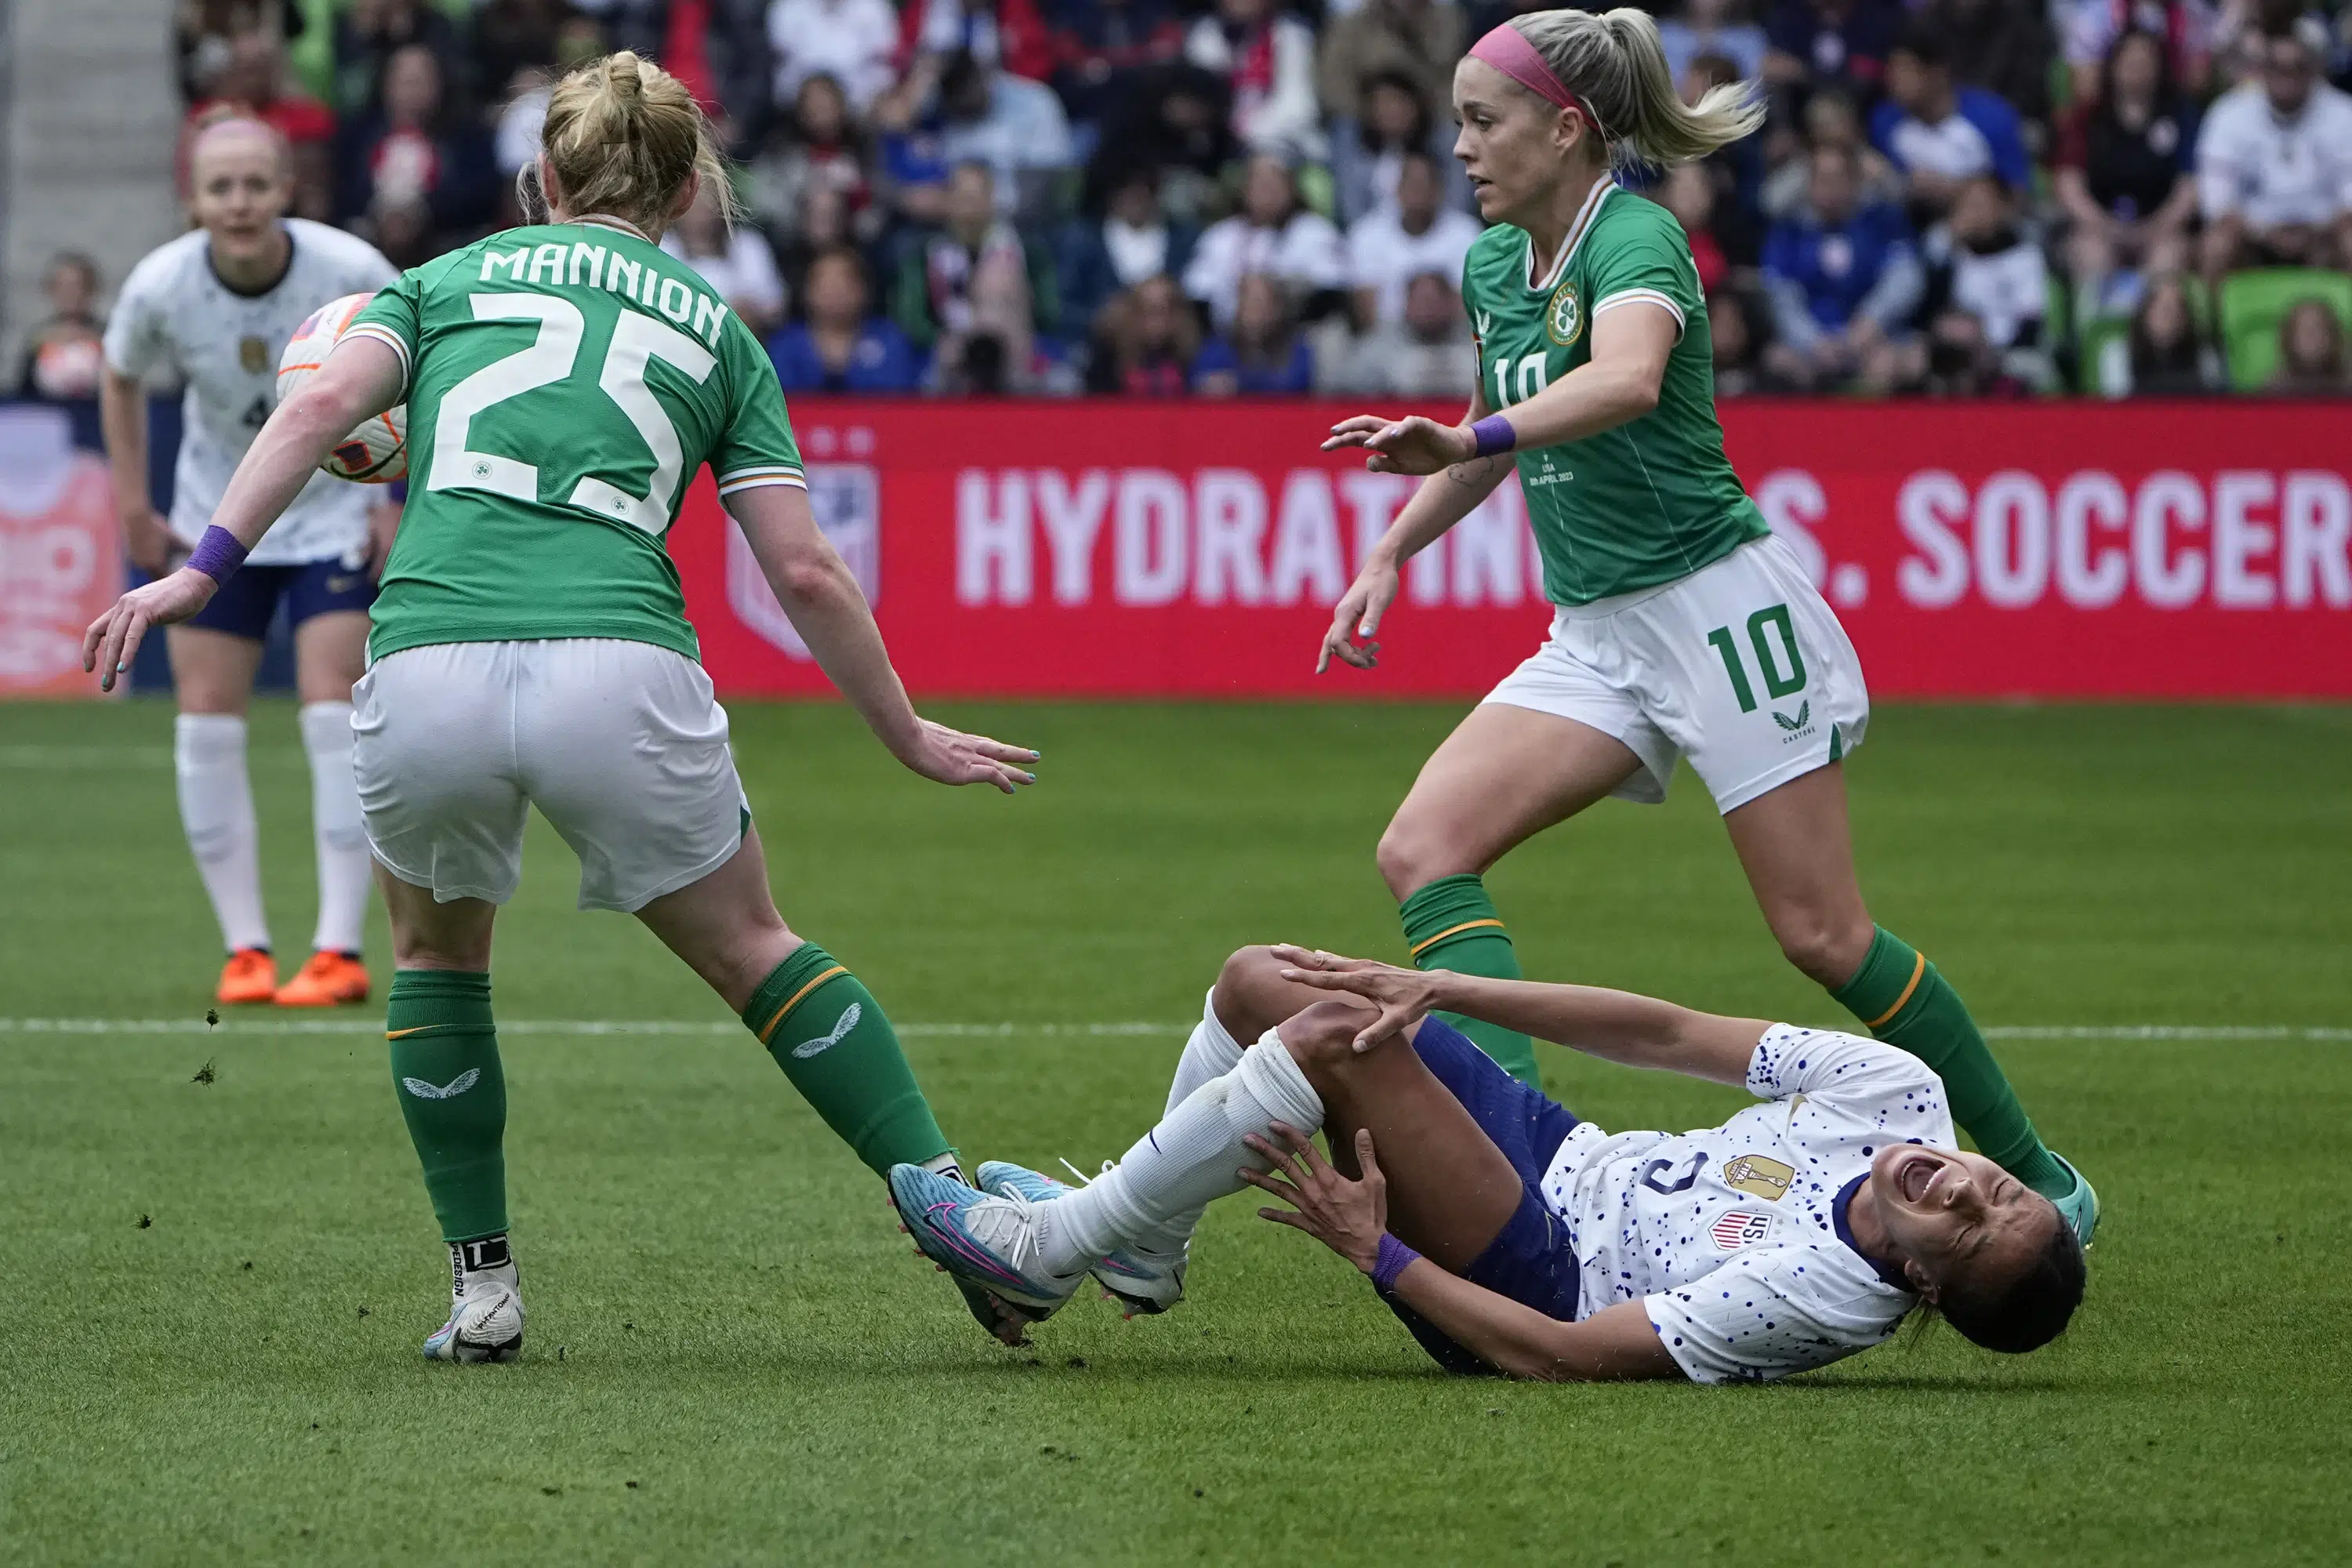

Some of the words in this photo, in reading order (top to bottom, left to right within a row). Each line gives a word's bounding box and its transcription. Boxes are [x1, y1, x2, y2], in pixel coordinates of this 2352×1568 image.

[478, 241, 728, 349] MANNION
[426, 292, 719, 537] 25
[953, 469, 1548, 607] HYDRATN
[1896, 468, 2352, 609] SOCCER
[1708, 603, 1807, 713] 10
[1783, 726, 1816, 744] CASTORE
[1736, 1163, 1752, 1181] FIFA
